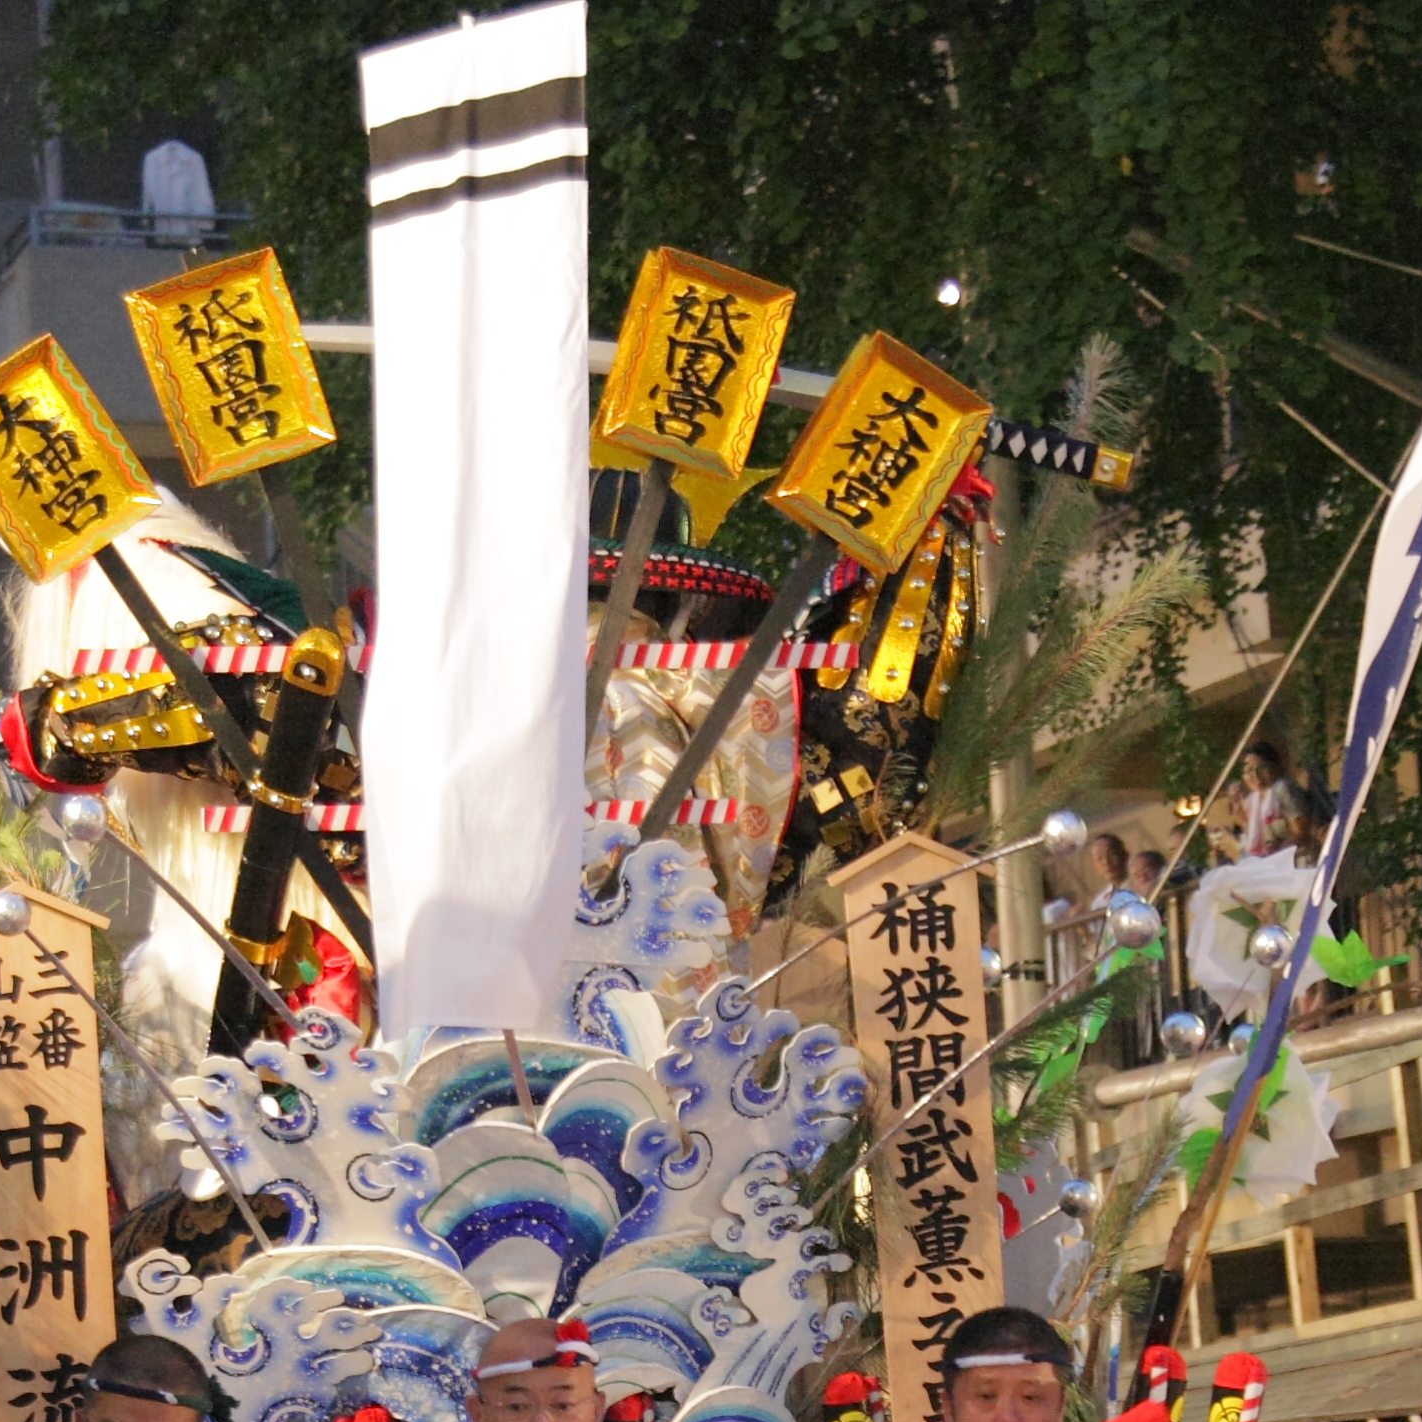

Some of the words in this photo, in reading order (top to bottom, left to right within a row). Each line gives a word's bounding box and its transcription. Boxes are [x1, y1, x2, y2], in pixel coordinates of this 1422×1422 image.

[174, 289, 281, 447] 祇園宮
[647, 284, 750, 446] 祇園宮
[824, 386, 939, 529] 大神宮
[29, 950, 86, 1069] 三番
